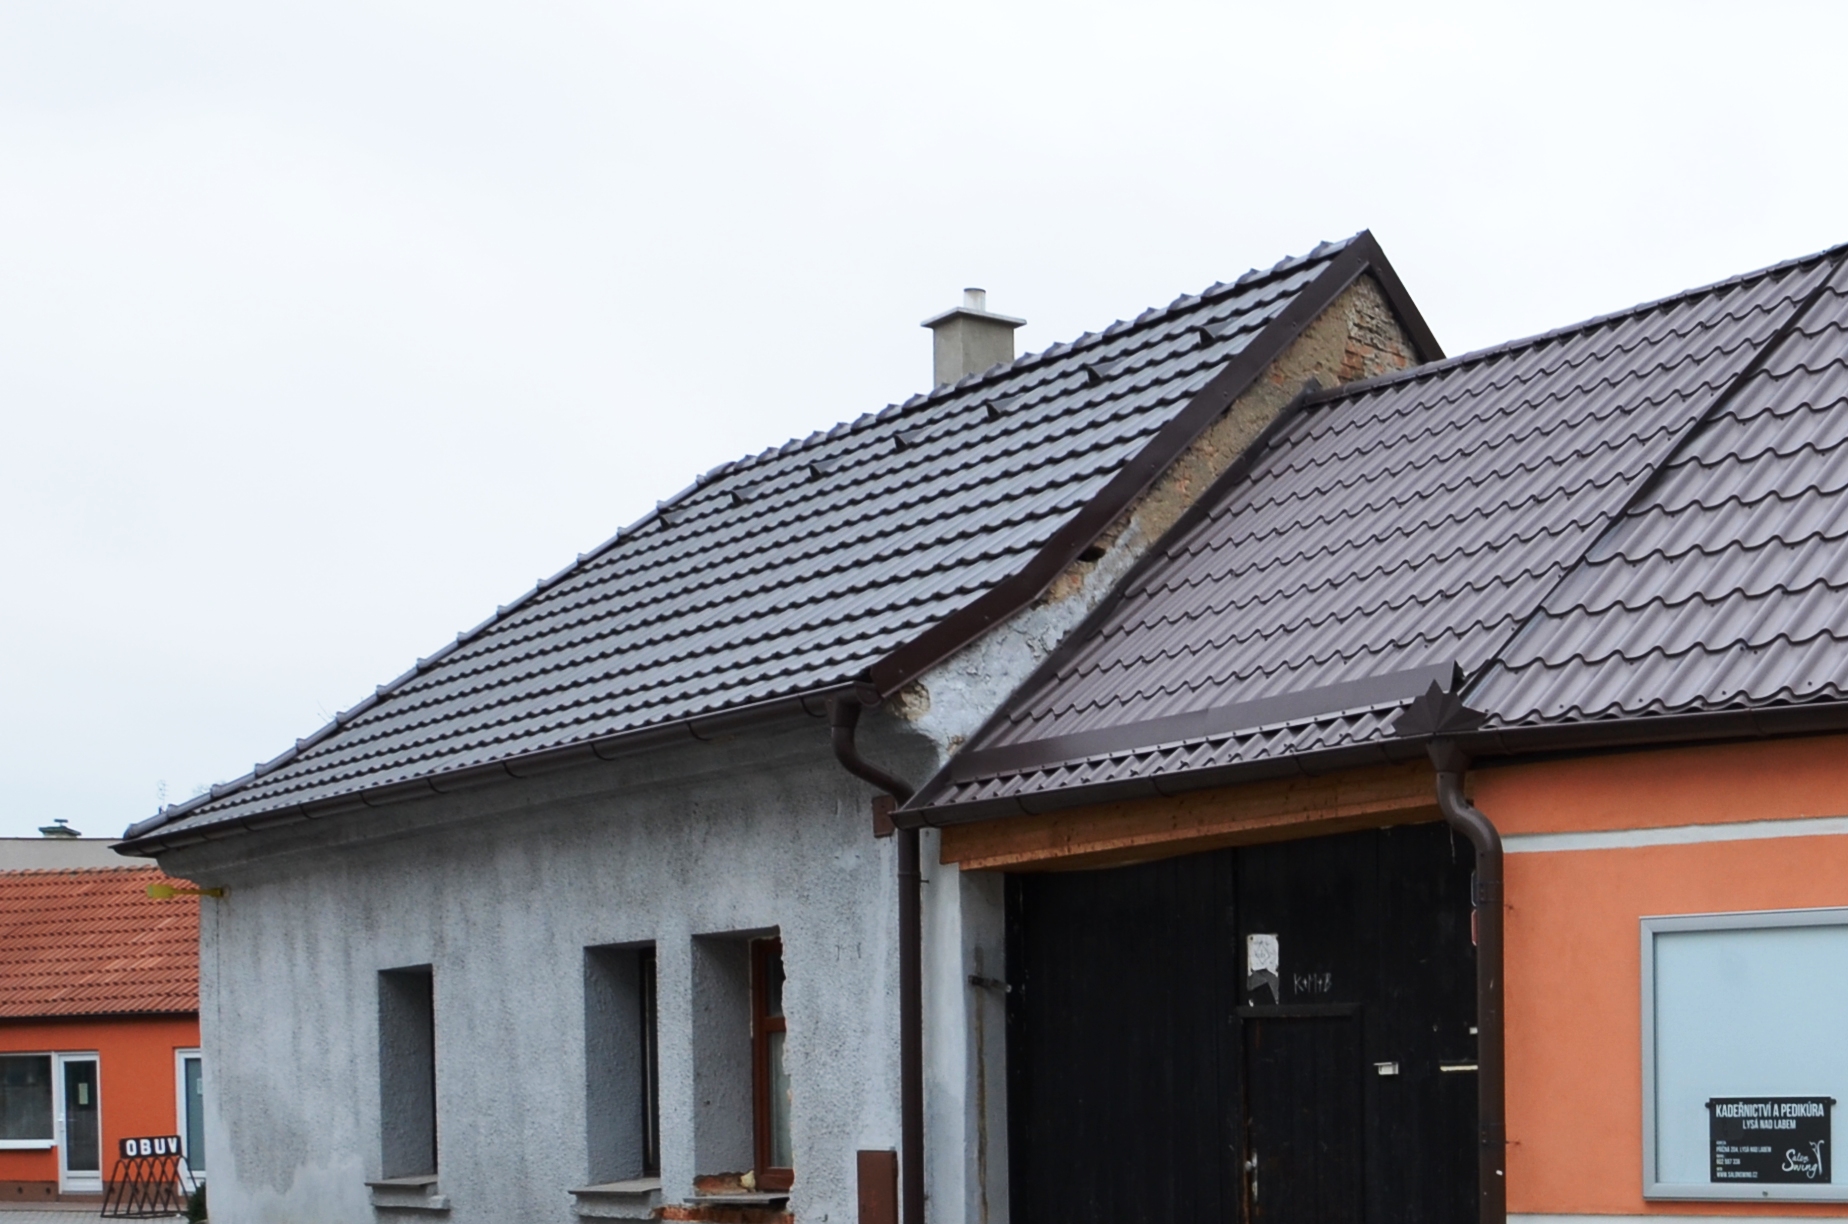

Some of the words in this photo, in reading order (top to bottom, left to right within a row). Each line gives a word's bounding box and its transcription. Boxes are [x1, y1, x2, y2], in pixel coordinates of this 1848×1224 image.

[1715, 1102, 1772, 1118] KADEŘNICTVÍ
[1773, 1103, 1780, 1117] A
[1780, 1101, 1825, 1117] PEDIKÚRA
[1742, 1118, 1759, 1130] LYSÁ
[1760, 1119, 1773, 1129] NAD
[1774, 1119, 1797, 1129] LABEM
[125, 1137, 178, 1156] OBUV
